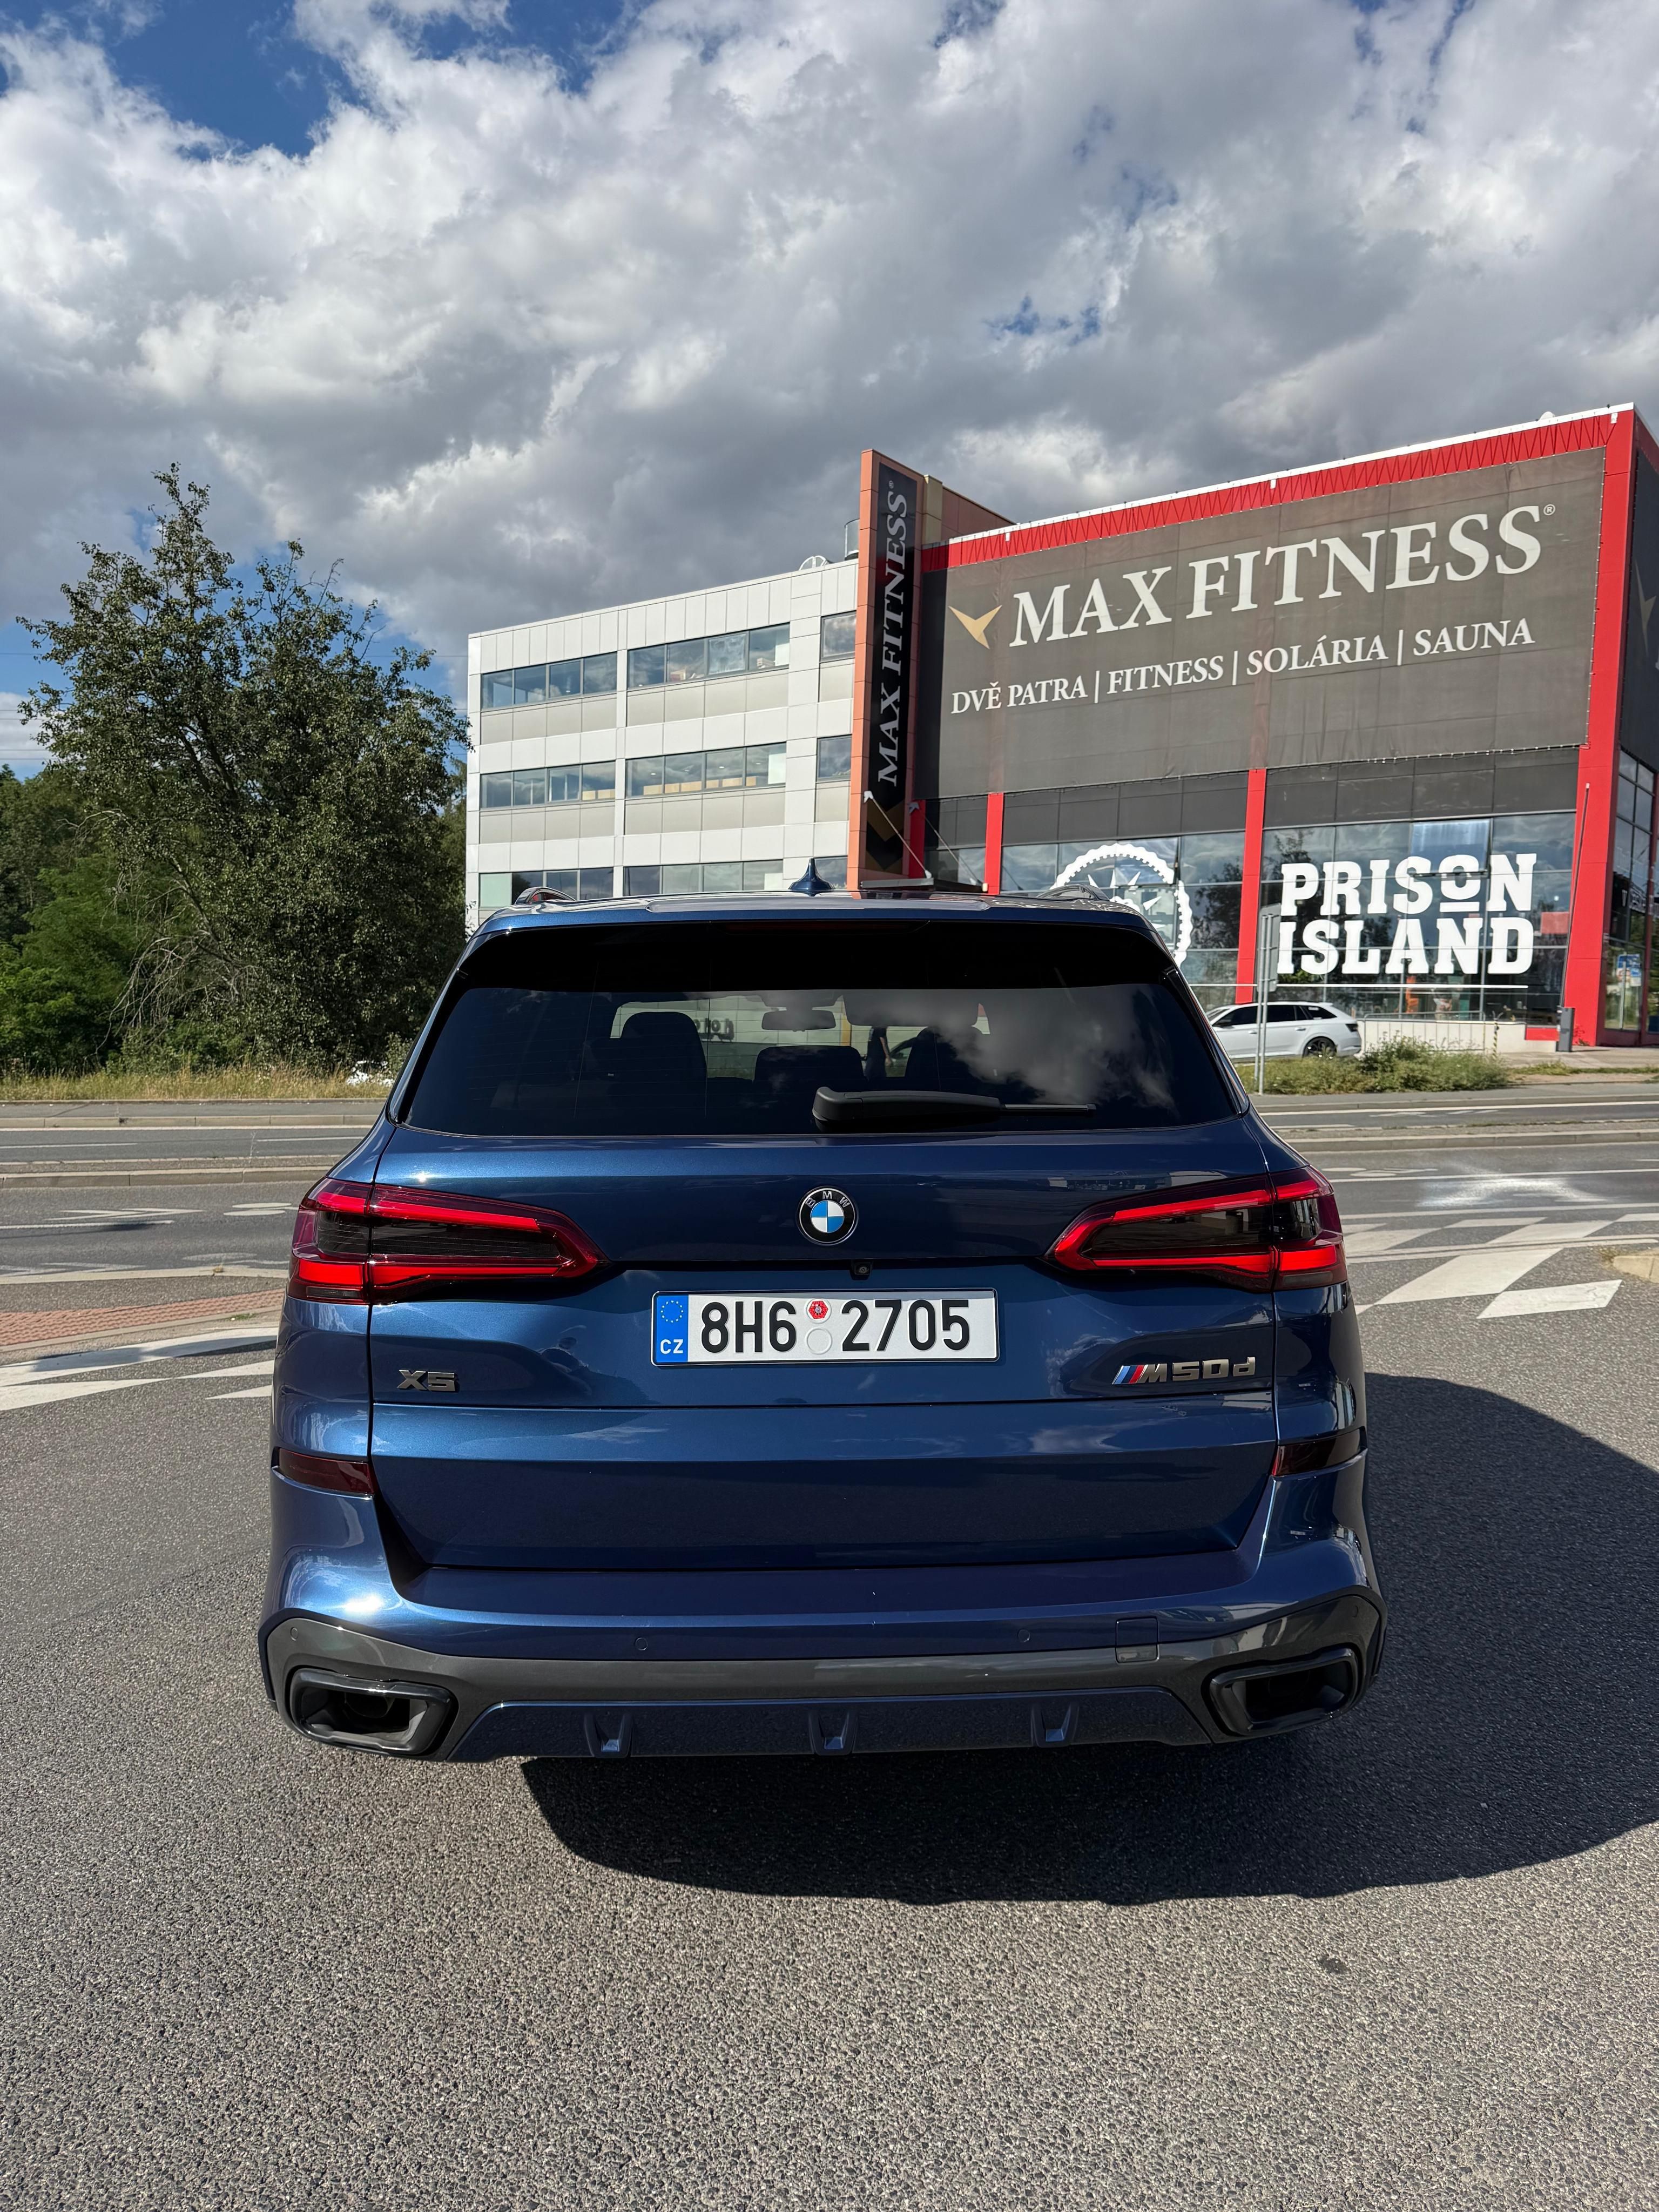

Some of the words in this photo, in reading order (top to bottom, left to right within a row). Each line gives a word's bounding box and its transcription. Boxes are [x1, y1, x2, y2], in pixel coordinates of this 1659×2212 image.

[1009, 566, 1172, 647] MAX
[951, 682, 1001, 714] DVĚ
[1007, 675, 1088, 707] PATRA
[1107, 655, 1224, 695] FITNESS
[1246, 635, 1388, 676] SOLÁRIA
[1413, 618, 1535, 656] SAUNA
[878, 682, 901, 787] MAX
[1280, 853, 1536, 916] PRISON
[1277, 916, 1534, 975] ISLAND
[805, 1190, 850, 1209] BMW
[660, 1339, 684, 1354] CZ
[701, 1301, 797, 1353] 8H6
[841, 1299, 970, 1352] 2705
[397, 1370, 456, 1392] X5
